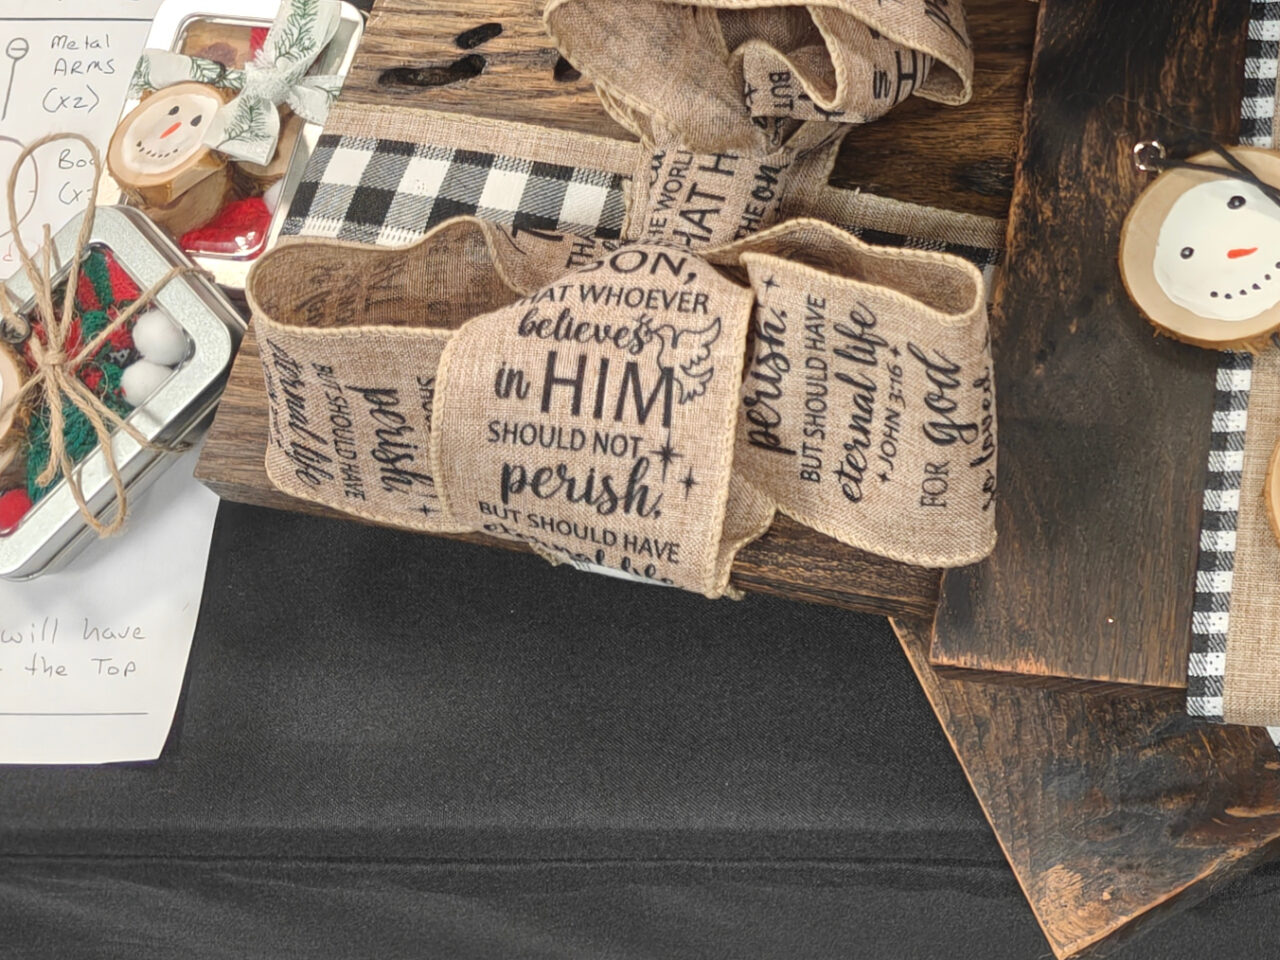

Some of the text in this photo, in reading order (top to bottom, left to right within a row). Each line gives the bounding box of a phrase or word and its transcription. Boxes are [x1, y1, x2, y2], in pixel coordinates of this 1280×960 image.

[50, 34, 111, 51] Metal
[768, 71, 794, 112] BUT
[579, 282, 709, 315] WHOEVER
[517, 307, 652, 356] believes
[493, 349, 676, 429] in HIM
[800, 293, 828, 483] BUT SHOULD HAVE
[833, 301, 889, 504] eternal life
[325, 391, 358, 459] SHOULD
[487, 420, 645, 458] SHOULD NOT
[878, 406, 904, 471] JOHN
[340, 459, 366, 501] HAVE
[920, 460, 949, 509] FOR
[478, 500, 522, 523] BUT
[527, 513, 617, 547] SHOULD
[622, 532, 681, 564] HAVE
[82, 617, 147, 642] have
[24, 652, 69, 678] the
